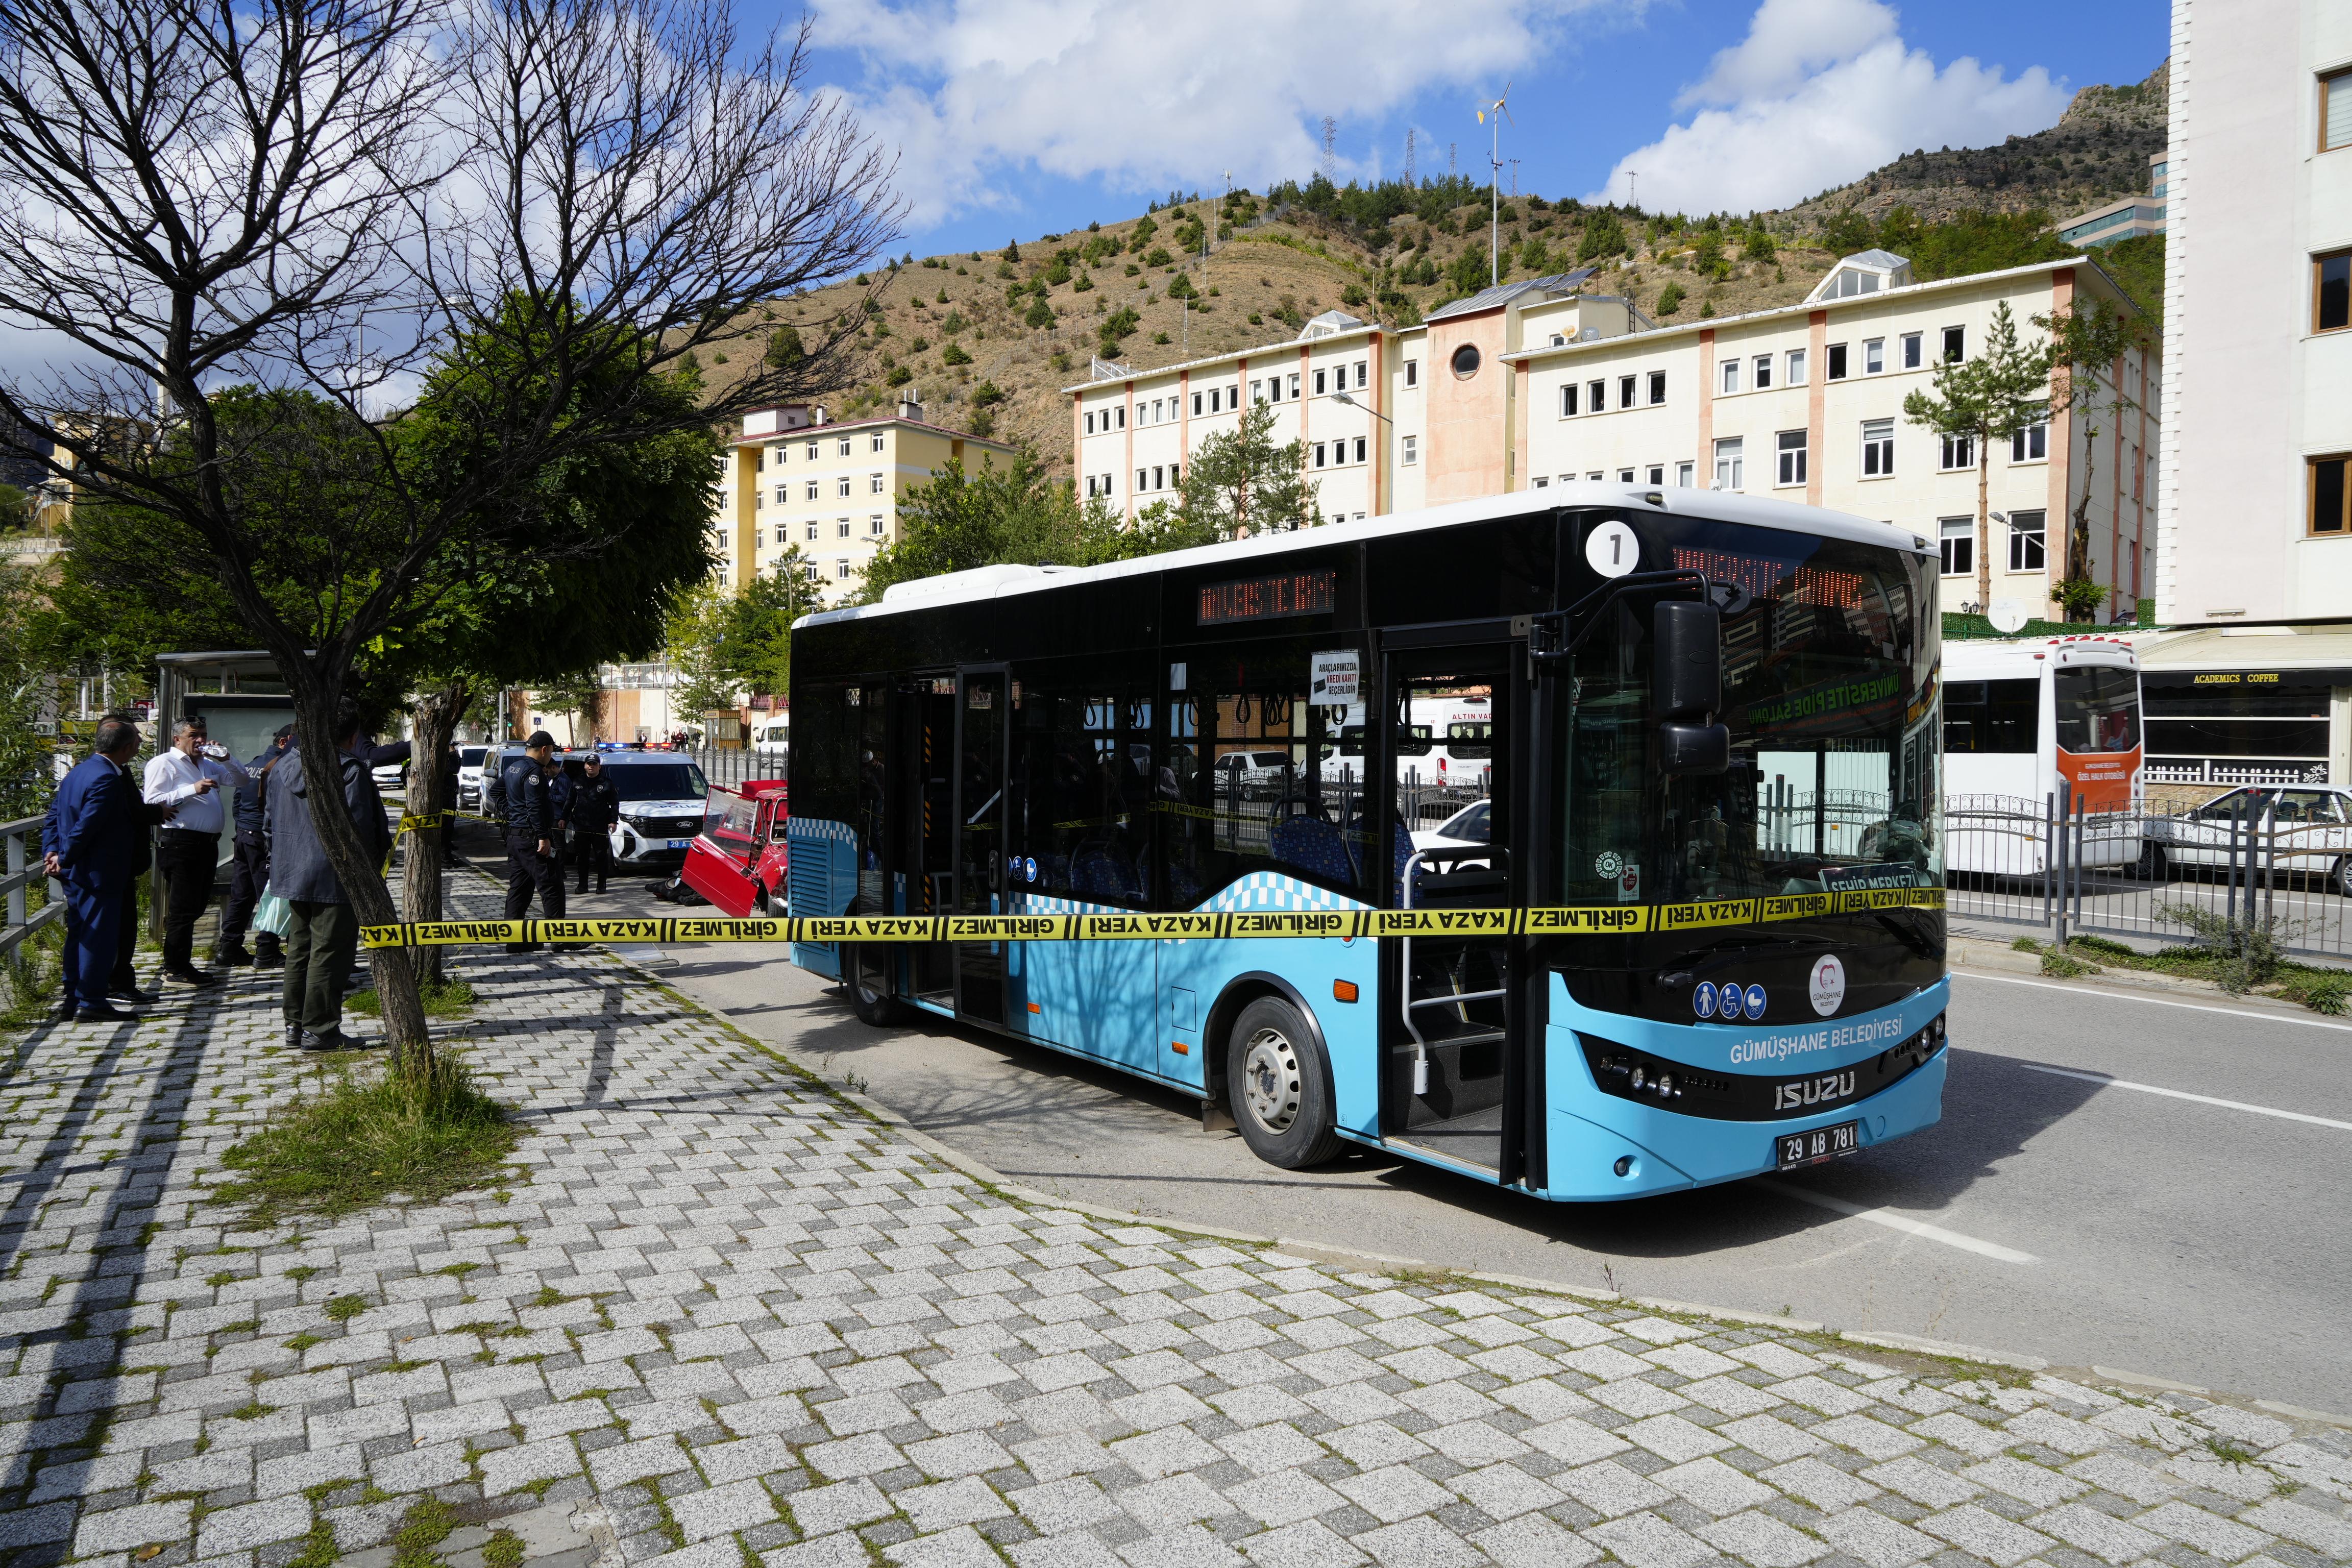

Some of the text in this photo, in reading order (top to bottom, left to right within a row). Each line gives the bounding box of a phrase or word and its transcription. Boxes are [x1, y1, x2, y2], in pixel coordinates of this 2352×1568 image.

[1610, 534, 1622, 565] 1
[1318, 663, 1357, 673] ARAÇLARIMIZDA
[1327, 673, 1357, 683] KREDİ KARTI
[2193, 674, 2279, 683] ACADEMICS COFFEE
[1328, 684, 1356, 696] GEÇERLİDİR
[412, 815, 440, 826] AZA
[1767, 895, 1827, 916] GİRİLMEZ
[1845, 891, 1902, 912] KAZA YERİ
[1237, 914, 1343, 935] GİRİLMEZ
[1379, 912, 1504, 934] KAZA YERİ
[1532, 910, 1637, 930] GİRİLMEZ
[1668, 902, 1751, 928] KAZA YERİ
[360, 926, 400, 942] KAZ
[419, 923, 512, 941] GİRİLMEZ
[544, 922, 657, 940] KAZA YERİ
[679, 921, 777, 940] GİRİLMEZ
[811, 920, 929, 939] KAZA YERİ
[953, 919, 1054, 938] GİRİLMEZ
[1090, 916, 1212, 937] KAZA YERİ
[1812, 991, 1841, 1001] GÜMÜŞHANE
[1730, 1014, 1902, 1064] GÜMÜŞHANE BELEDİYESİ
[1774, 1071, 1855, 1111] ISUZU
[1787, 1126, 1853, 1161] 29 AB 781
[1812, 1155, 1830, 1165] ISUZU
